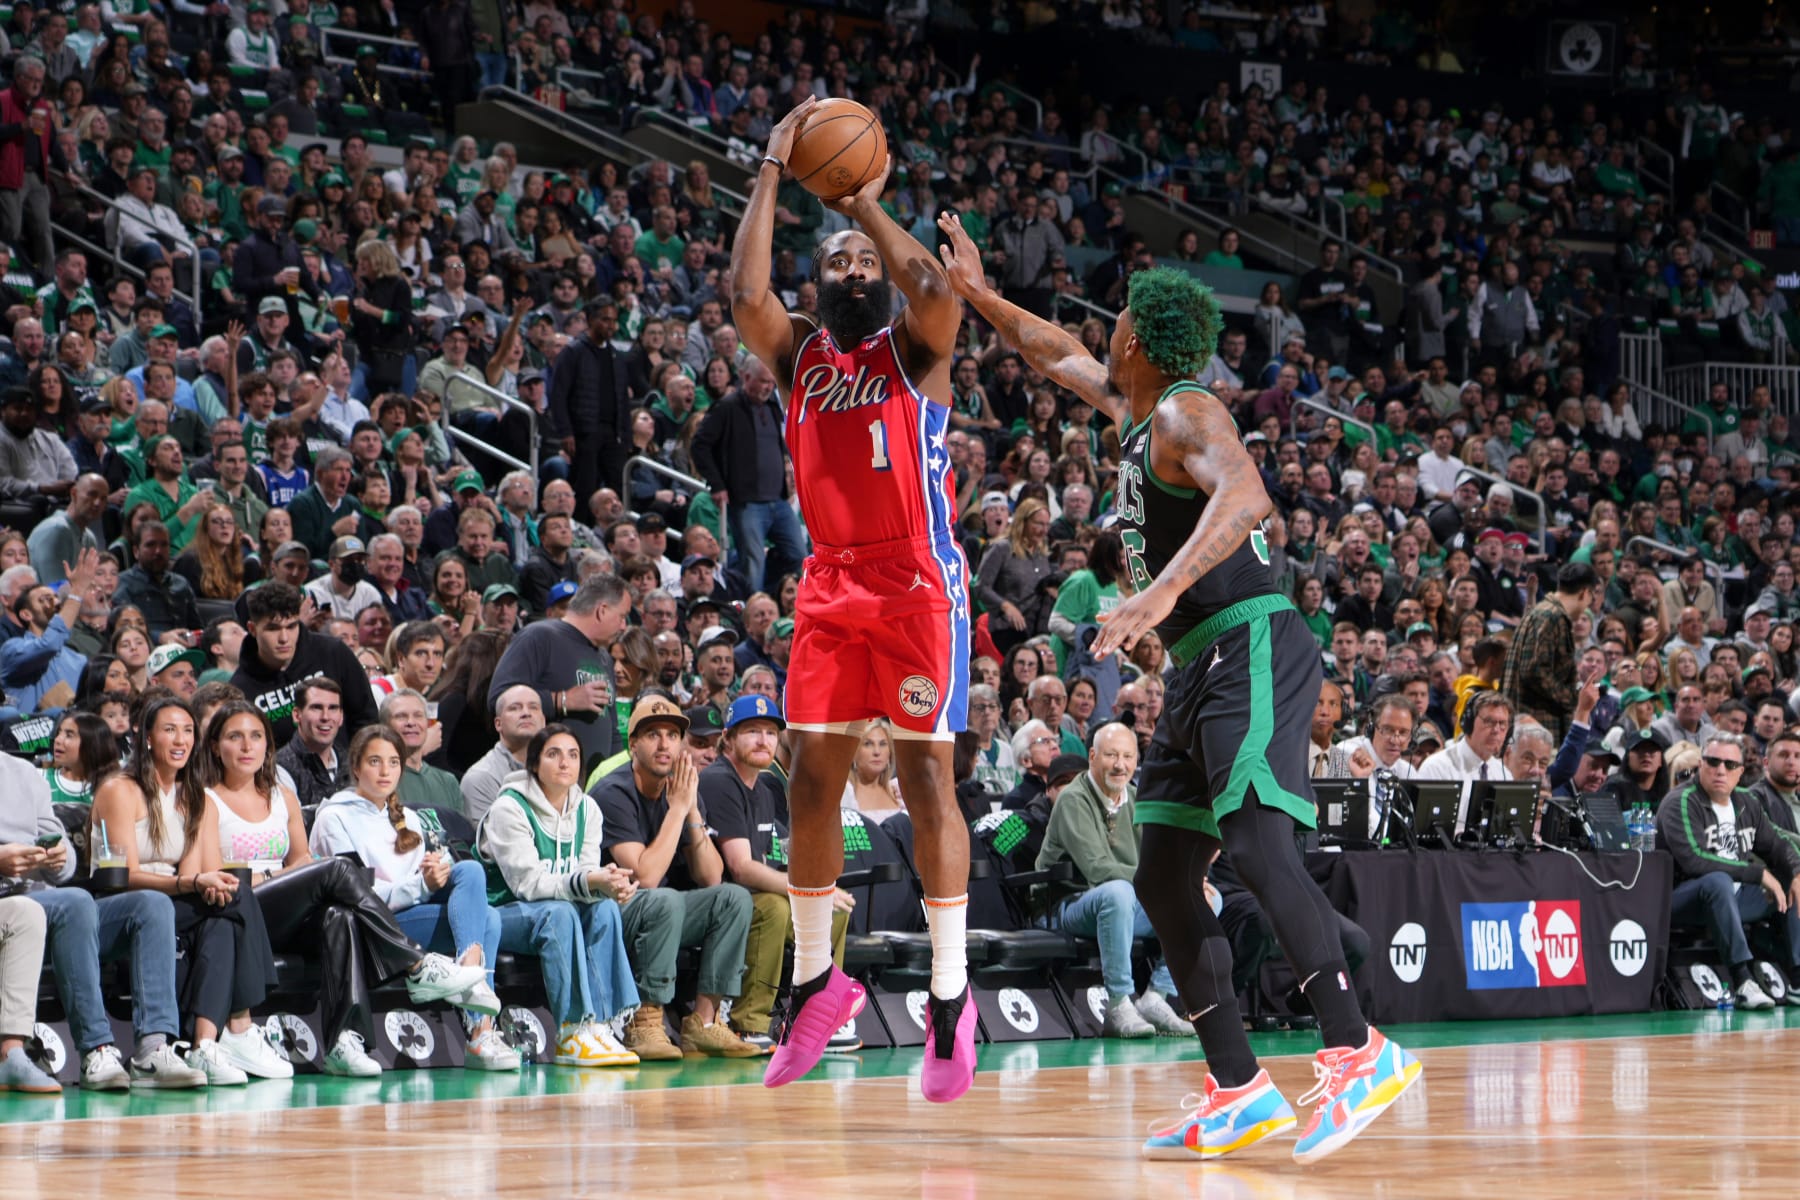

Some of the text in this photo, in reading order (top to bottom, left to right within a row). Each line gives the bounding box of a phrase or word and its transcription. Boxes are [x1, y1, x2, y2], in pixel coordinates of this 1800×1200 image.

[1754, 231, 1772, 249] EXIT
[1776, 271, 1800, 289] ank
[868, 419, 890, 470] 1
[271, 488, 302, 505] PHIL
[1390, 942, 1427, 967] TNT
[1471, 919, 1514, 971] NBA
[1544, 932, 1579, 960] TNT
[1610, 938, 1648, 962] TNT
